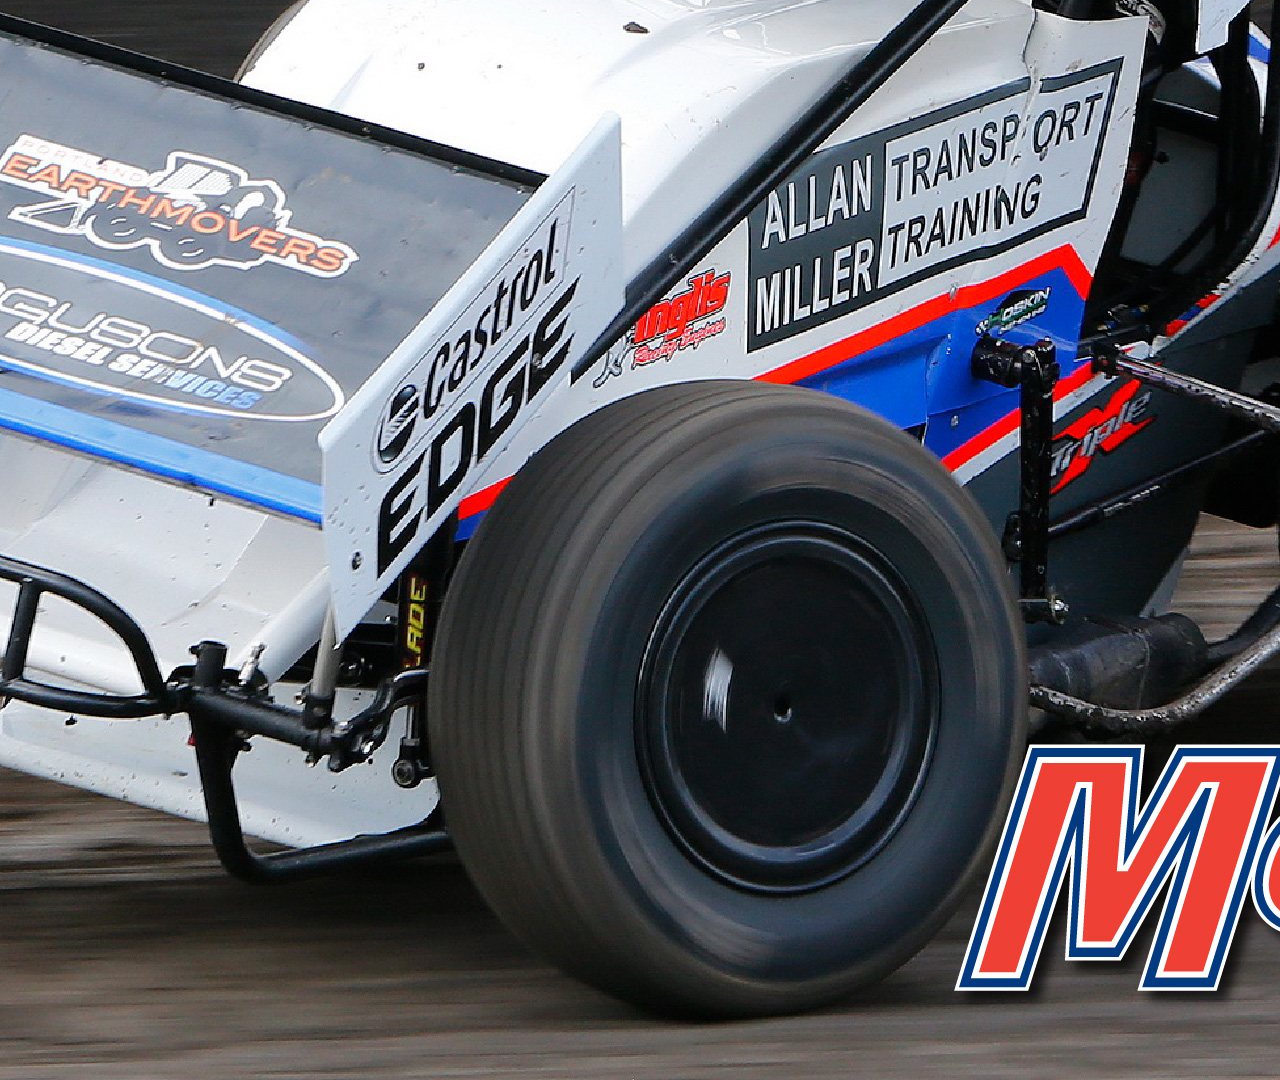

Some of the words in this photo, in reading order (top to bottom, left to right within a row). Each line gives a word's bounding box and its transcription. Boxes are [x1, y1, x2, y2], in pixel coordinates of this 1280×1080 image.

[890, 92, 1103, 203] TRANSPORT
[1, 152, 348, 272] EARTHMOVERS
[761, 152, 874, 250] ALLAN
[887, 175, 1043, 272] TRAINING
[423, 217, 559, 420] Castrol
[755, 238, 876, 336] MILLER
[4, 322, 113, 366] DIESEL
[107, 352, 264, 410] SERVICES
[377, 275, 581, 580] EDGE
